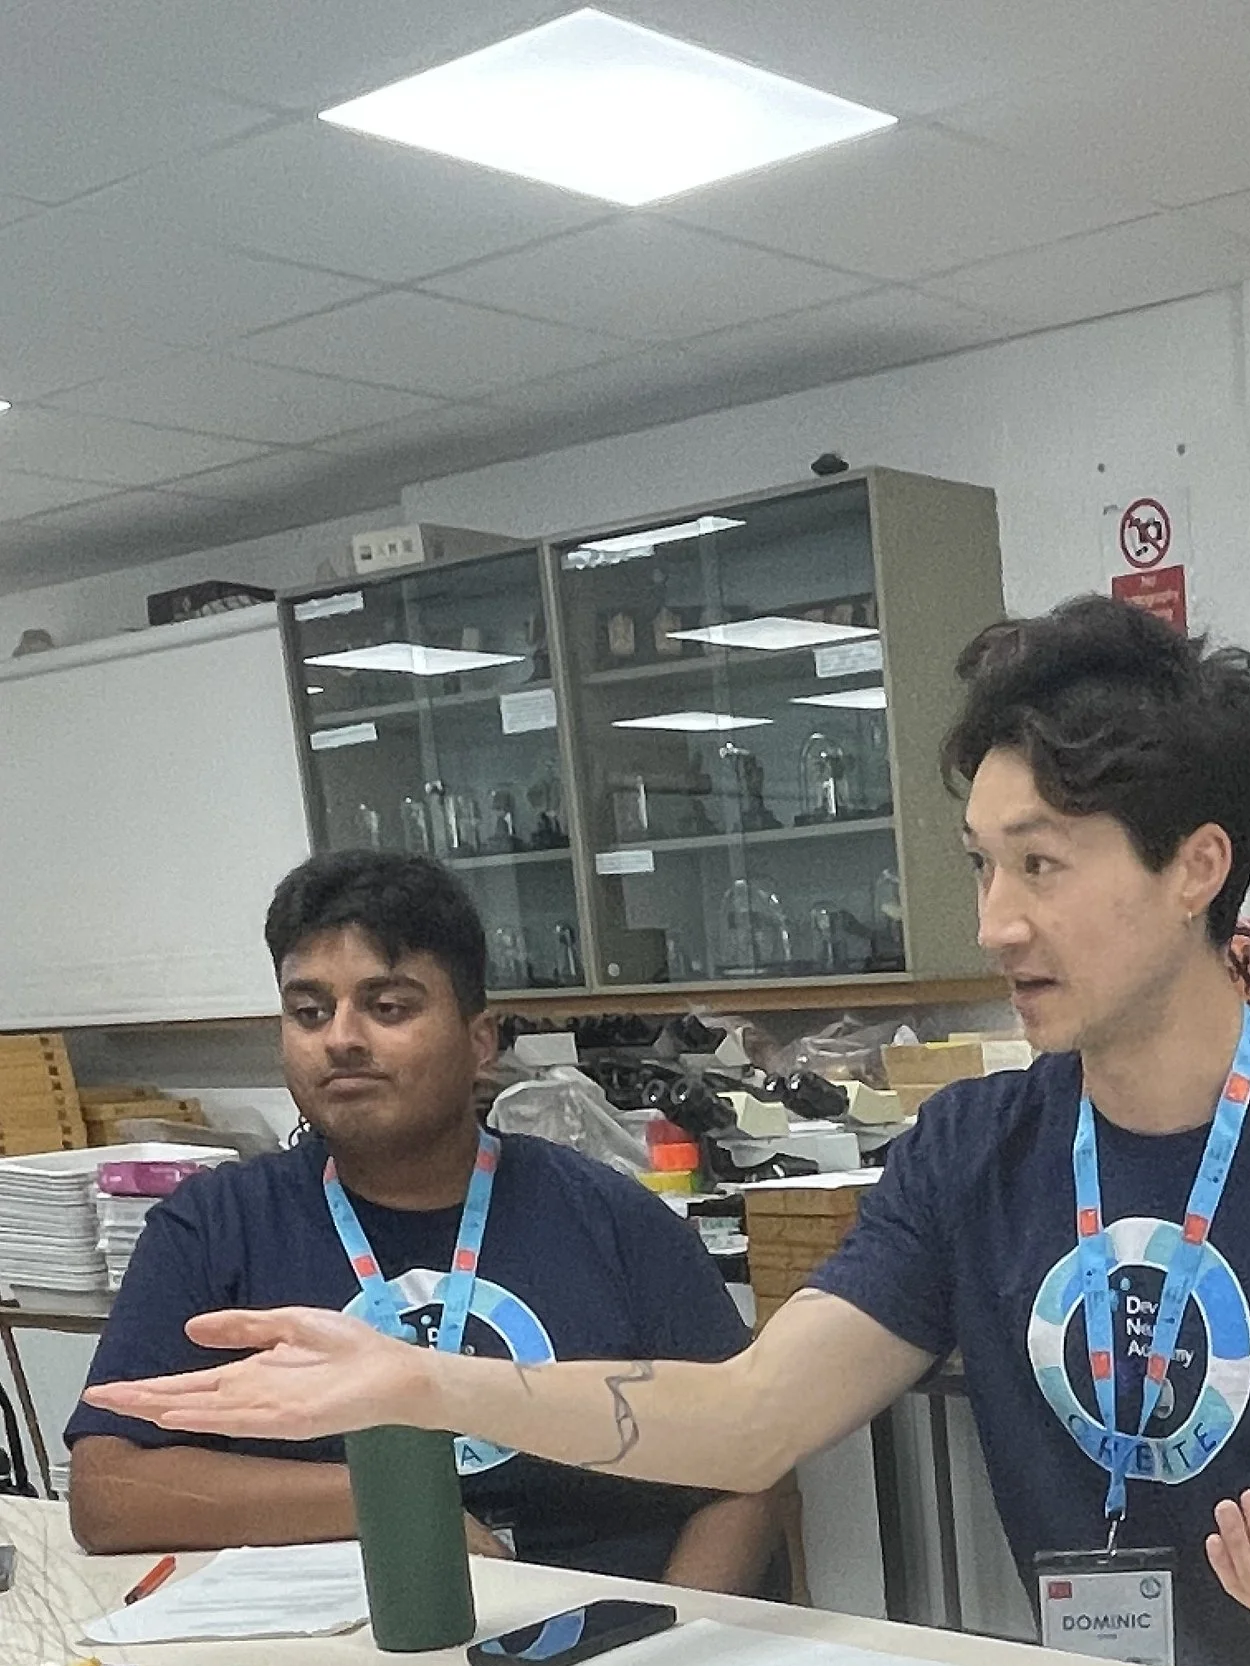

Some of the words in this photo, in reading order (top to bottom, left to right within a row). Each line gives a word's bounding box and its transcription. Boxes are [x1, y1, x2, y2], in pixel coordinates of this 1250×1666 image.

[1126, 1295, 1158, 1314] Dev
[1127, 1339, 1194, 1368] Acmy
[1063, 1612, 1152, 1631] DOMINIC
